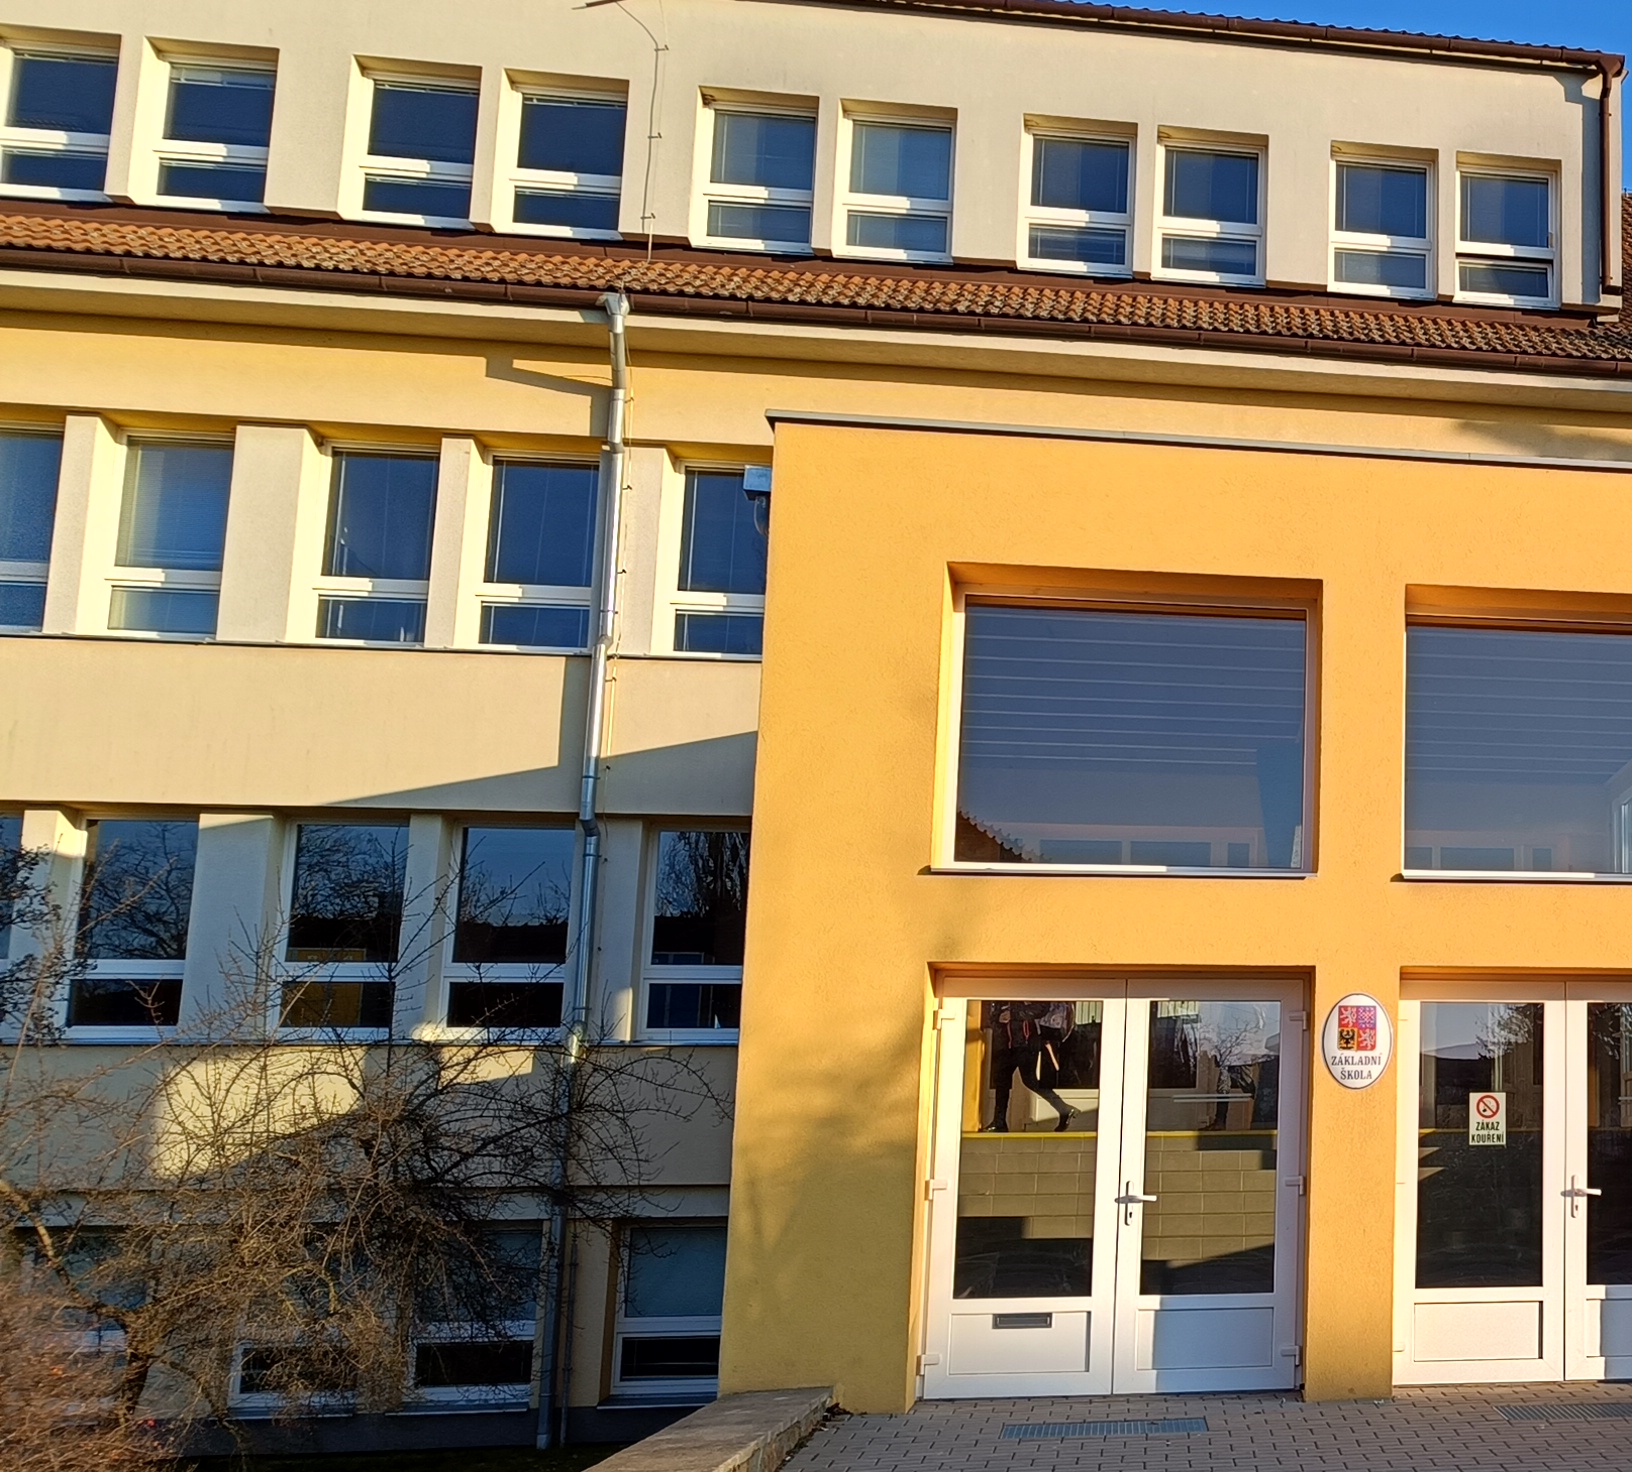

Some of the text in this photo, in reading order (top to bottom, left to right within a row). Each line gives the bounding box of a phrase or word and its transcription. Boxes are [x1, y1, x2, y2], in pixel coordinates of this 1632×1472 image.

[1331, 1052, 1382, 1066] ZÁKLADNÍ
[1340, 1067, 1372, 1080] ŠKOLA
[1475, 1120, 1500, 1131] ZÁKAZ
[1471, 1132, 1504, 1144] KOUŘENÍ
